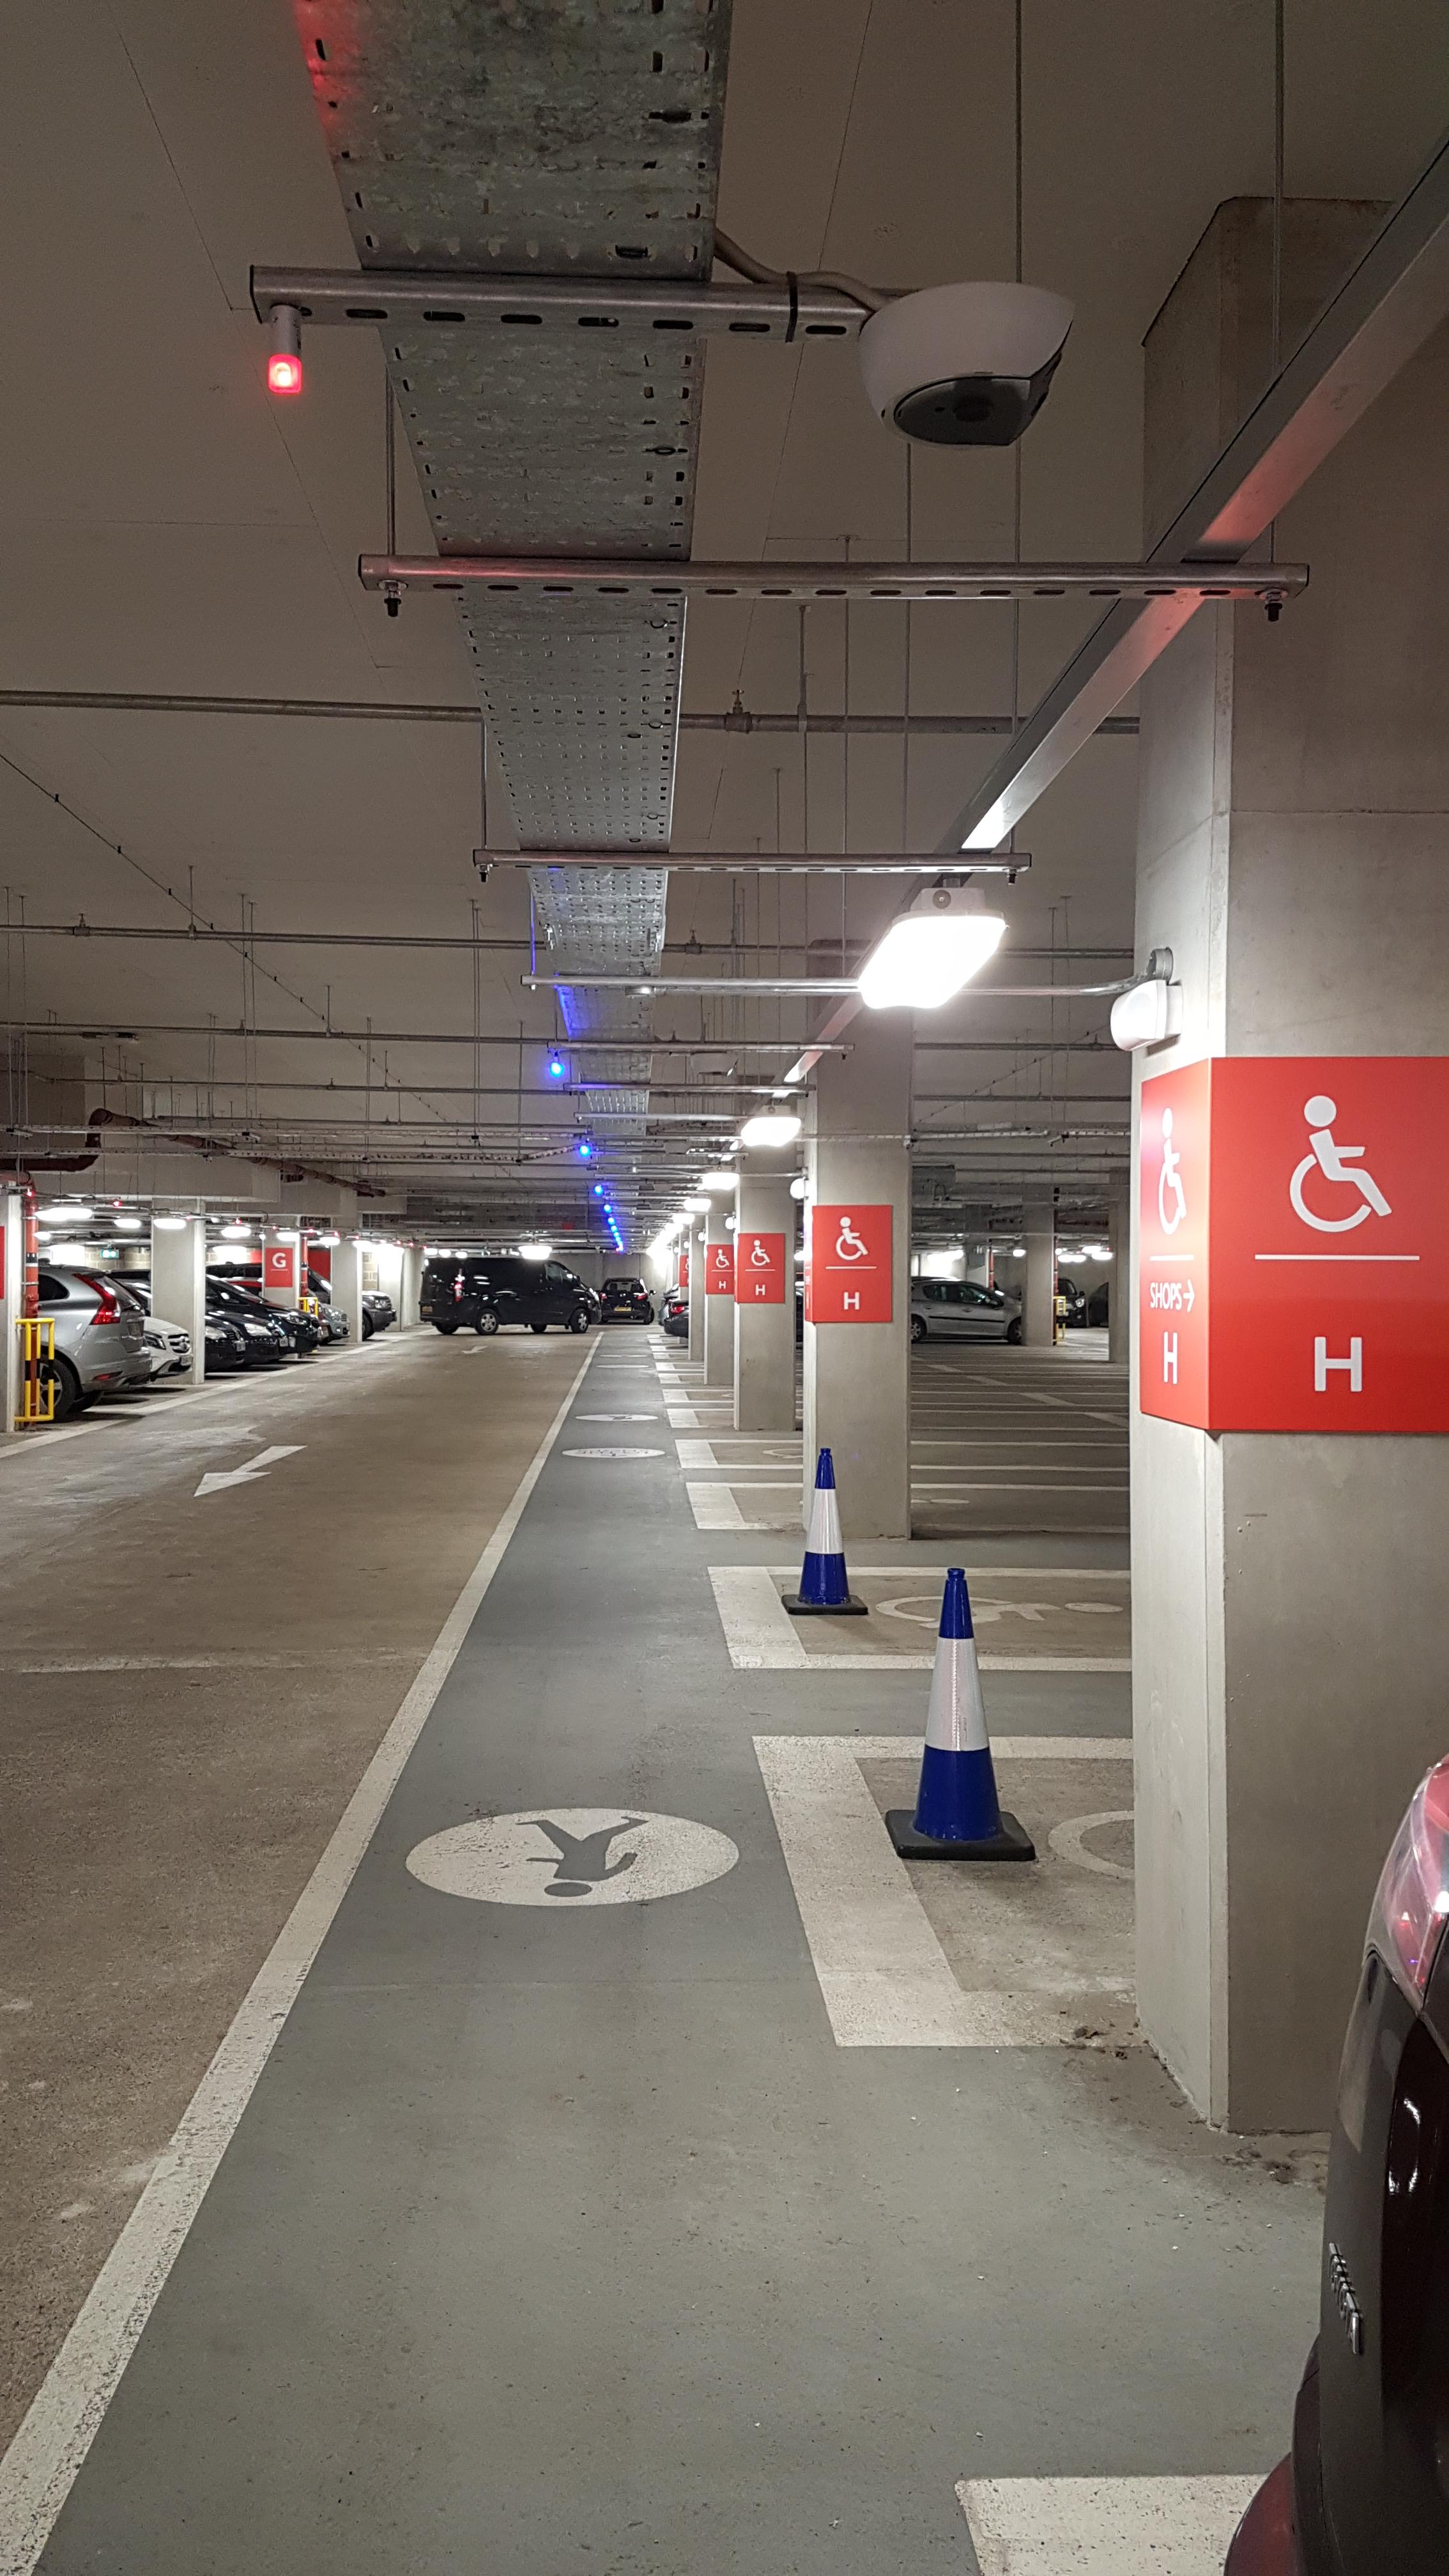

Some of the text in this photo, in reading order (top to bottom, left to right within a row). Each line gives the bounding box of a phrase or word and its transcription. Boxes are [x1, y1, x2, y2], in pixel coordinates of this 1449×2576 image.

[273, 1253, 286, 1268] G
[719, 1280, 726, 1289] H
[755, 1284, 765, 1296] H
[843, 1292, 859, 1310] H
[1149, 1282, 1183, 1310] SHOPS
[1163, 1331, 1178, 1385] H
[1314, 1337, 1362, 1392] H
